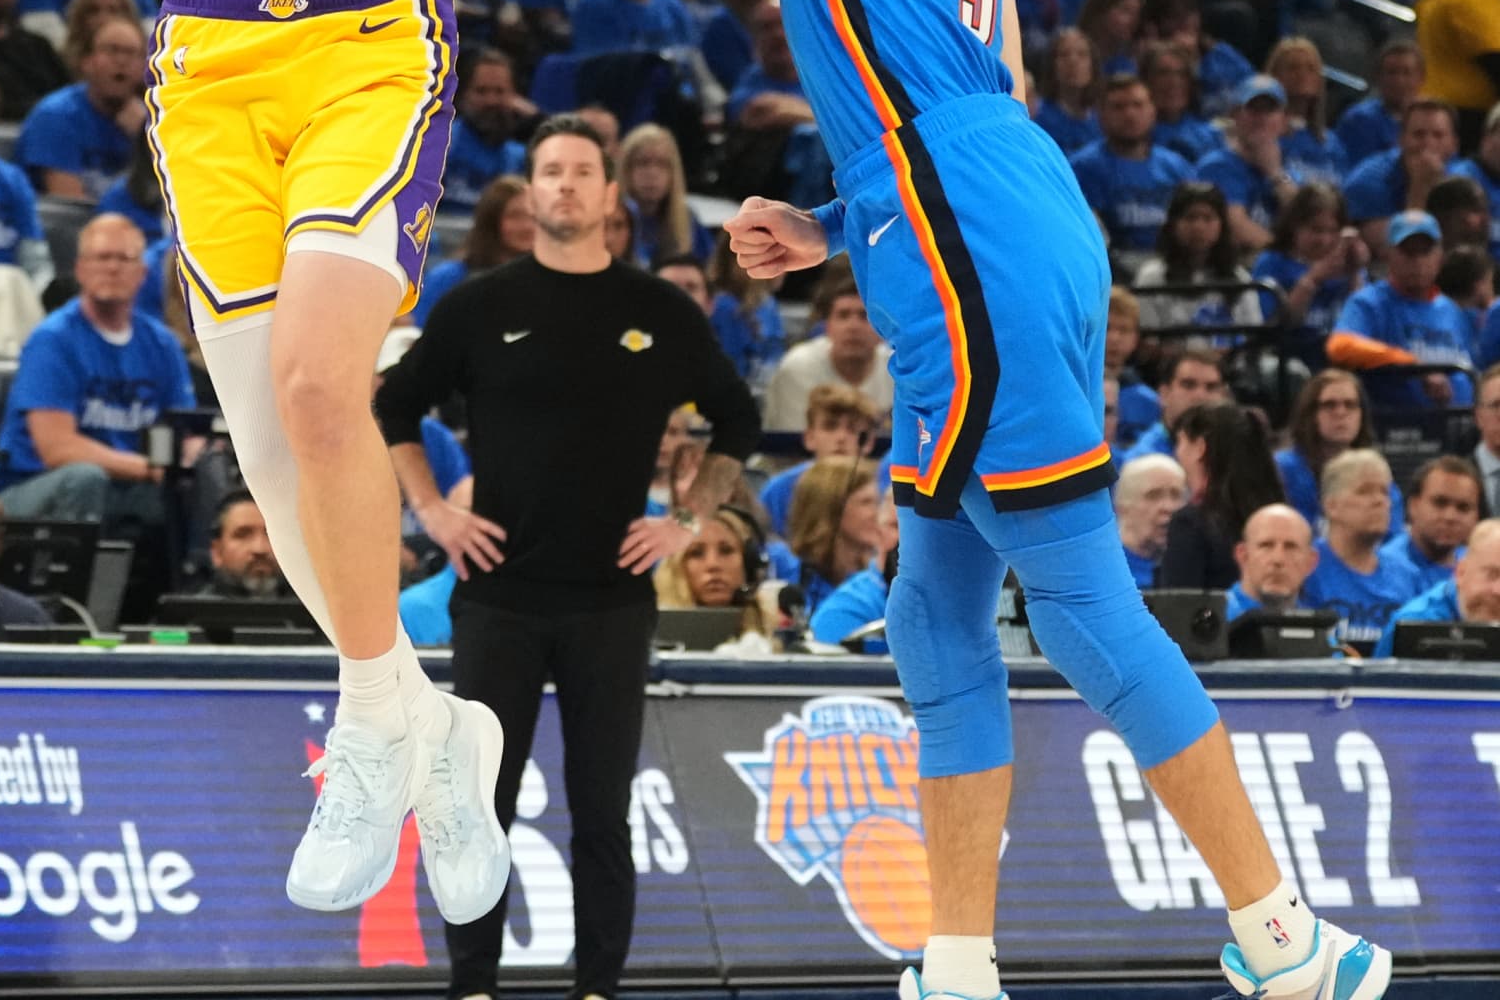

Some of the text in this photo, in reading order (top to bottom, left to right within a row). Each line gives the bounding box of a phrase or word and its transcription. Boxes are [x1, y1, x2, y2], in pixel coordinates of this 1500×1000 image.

[34, 733, 84, 816] by
[767, 728, 920, 843] KNICK
[1335, 731, 1421, 907] 2
